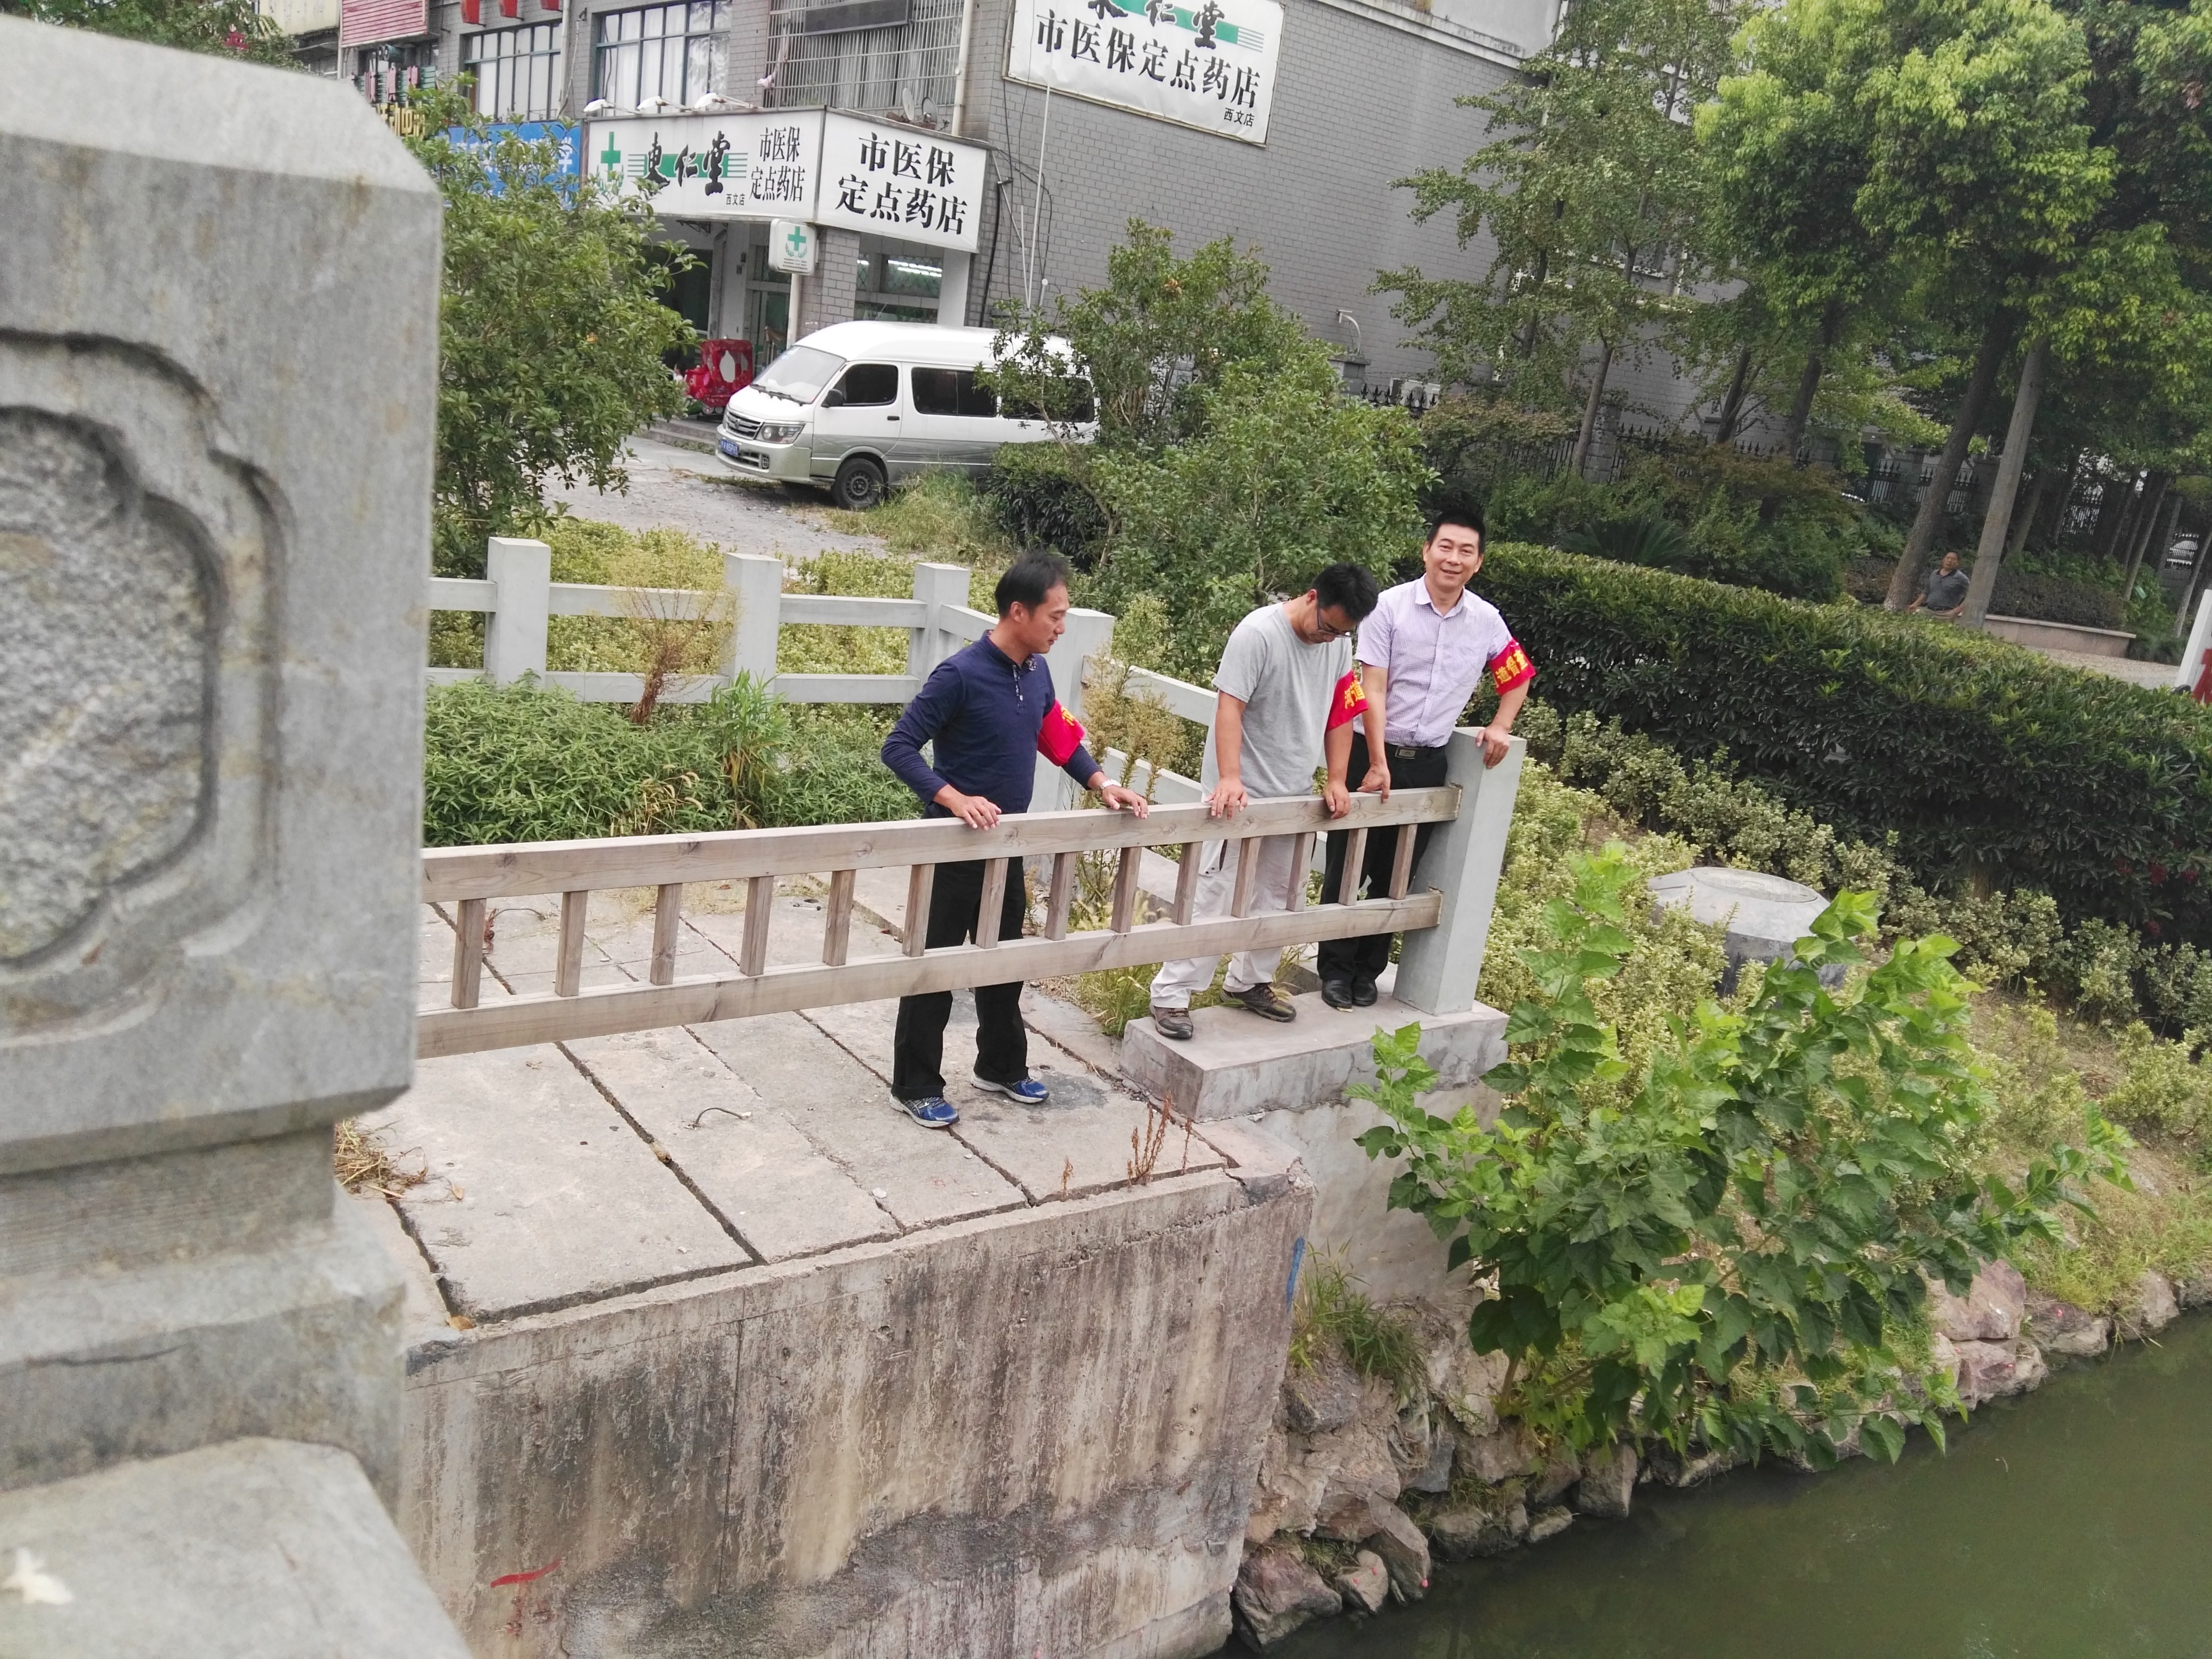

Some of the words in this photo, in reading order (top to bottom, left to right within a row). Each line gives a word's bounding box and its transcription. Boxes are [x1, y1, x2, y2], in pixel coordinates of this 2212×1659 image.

[1036, 9, 1261, 108] 市医保定点药店
[1224, 107, 1254, 128] 西文店
[759, 126, 800, 162] 市医保
[858, 132, 955, 187] 市医保
[726, 193, 745, 206] 西文店
[749, 165, 806, 202] 定点药店
[835, 174, 967, 235] 定点药店
[1495, 649, 1528, 688] 道督查
